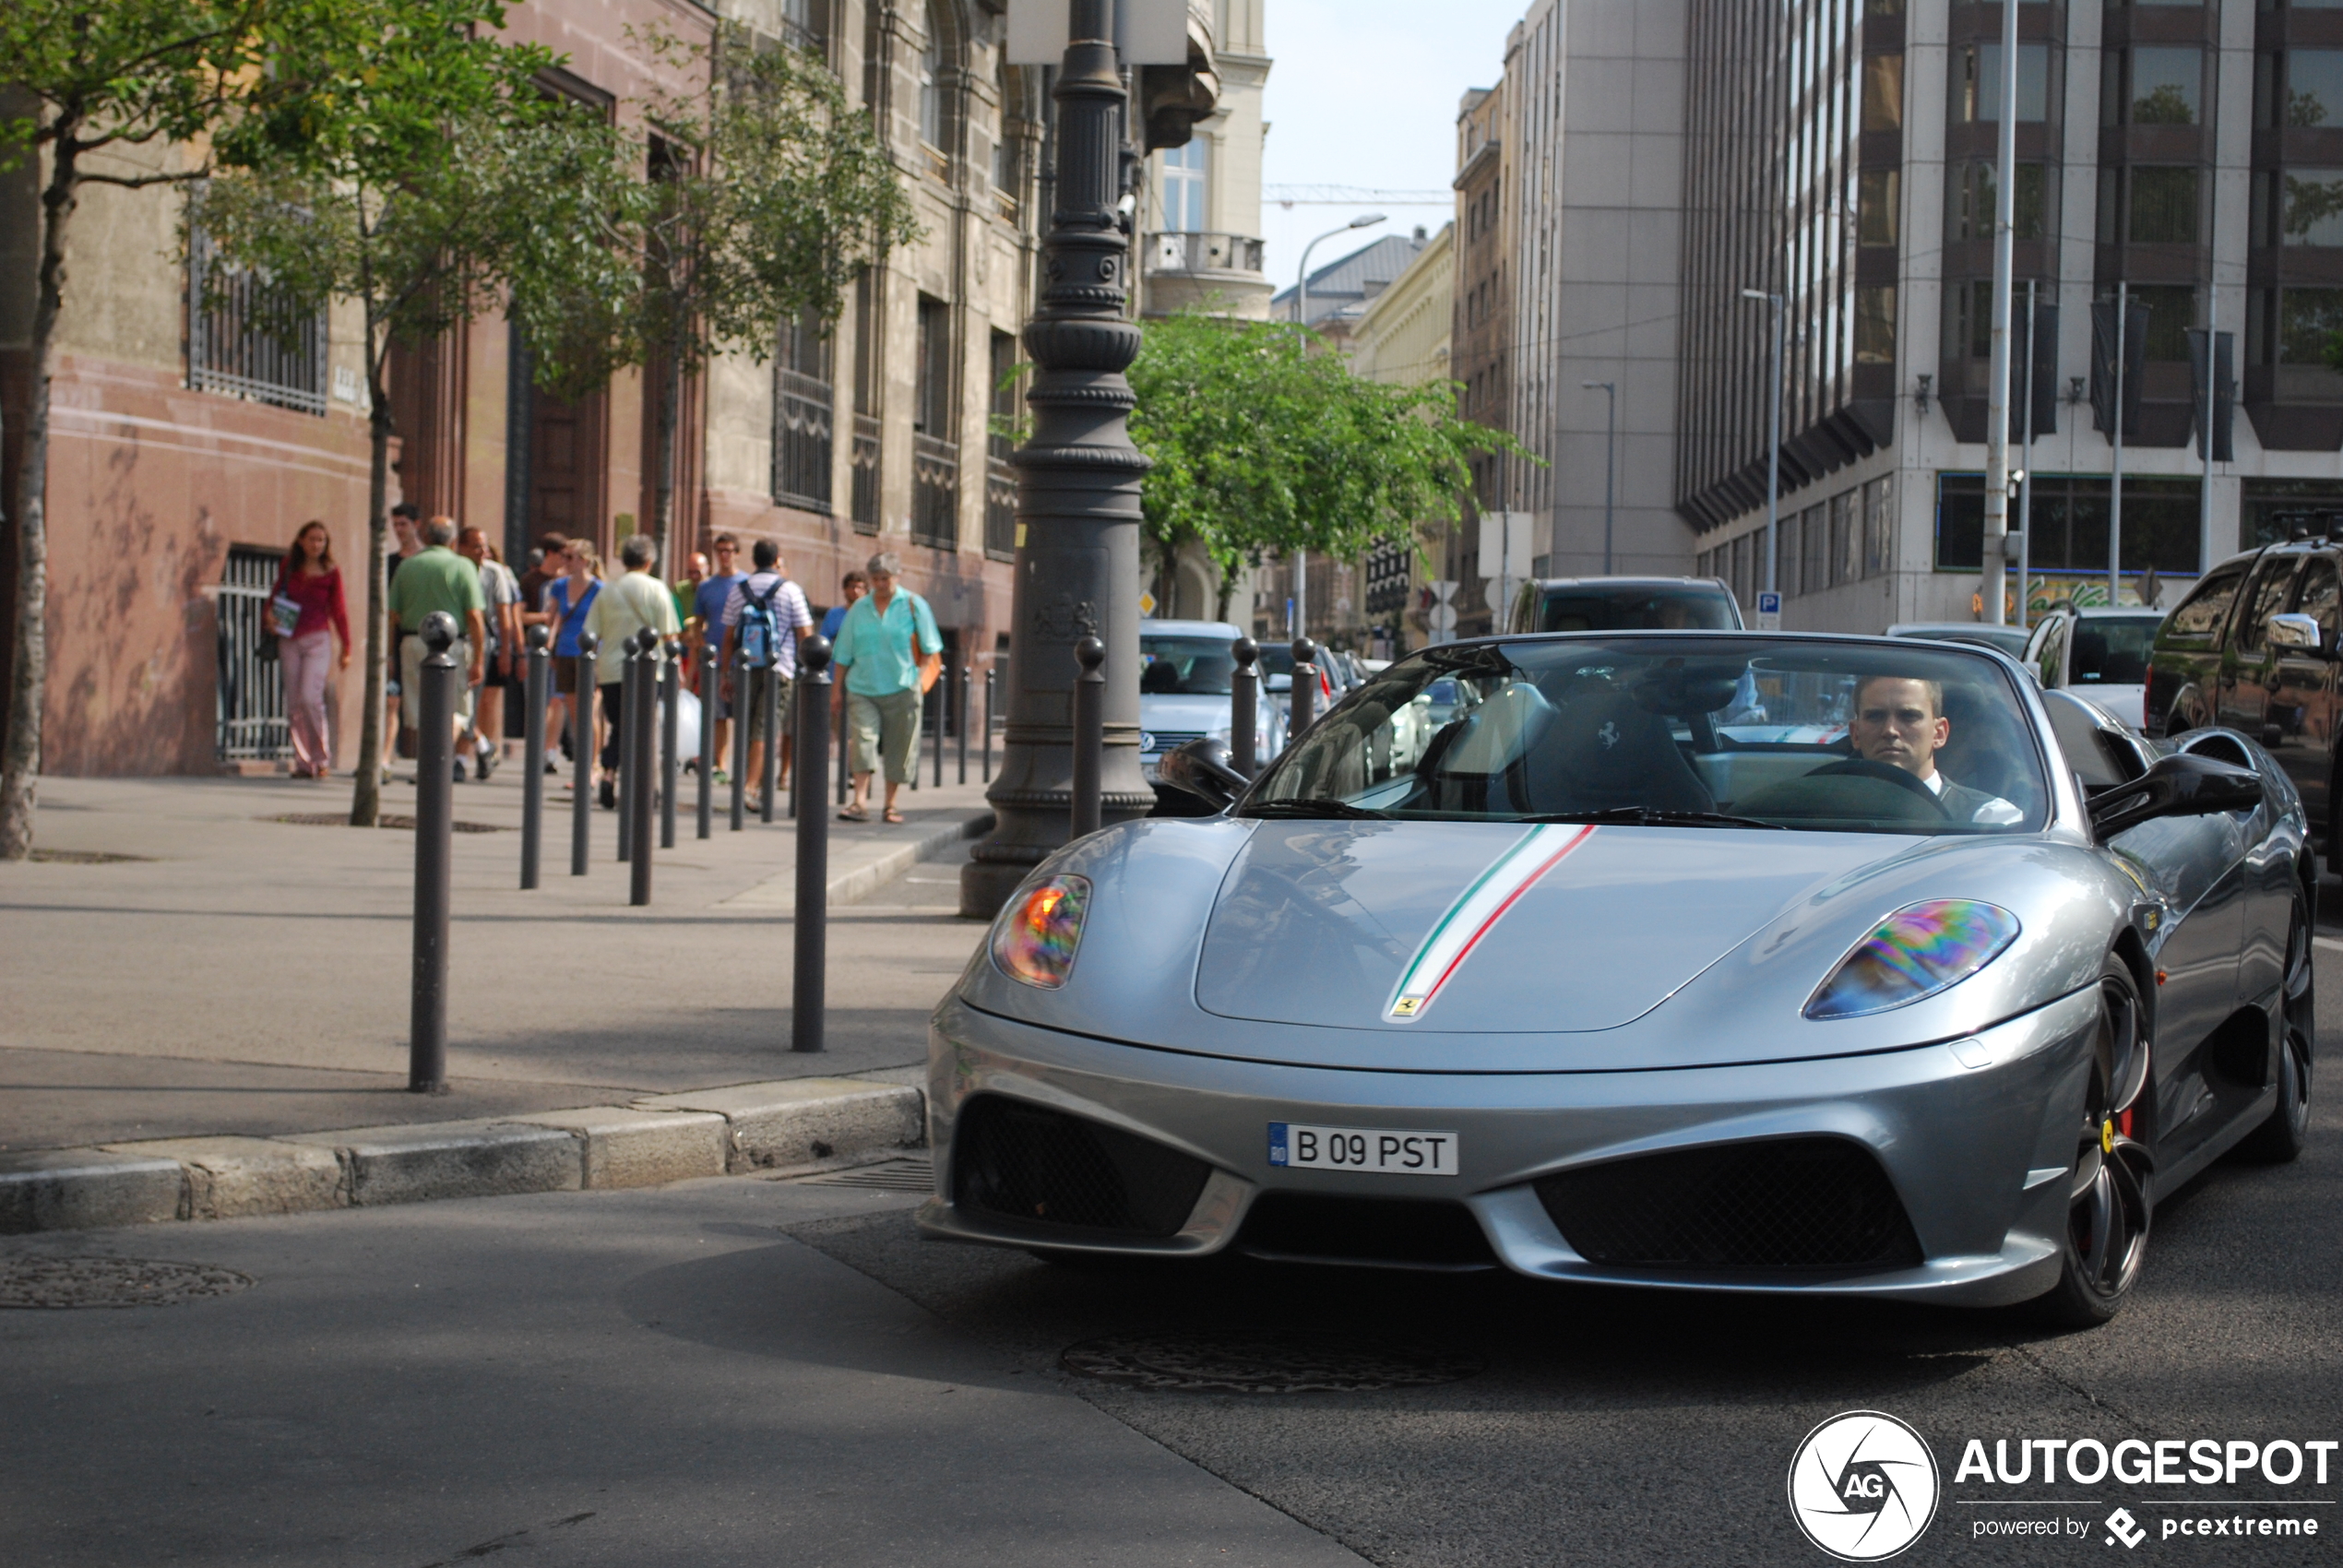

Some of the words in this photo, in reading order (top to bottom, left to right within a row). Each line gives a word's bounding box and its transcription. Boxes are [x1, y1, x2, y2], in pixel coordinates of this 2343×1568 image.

[1763, 596, 1777, 611] P
[1298, 1131, 1318, 1162] B
[1329, 1134, 1366, 1166] 09
[1379, 1135, 1446, 1169] PST
